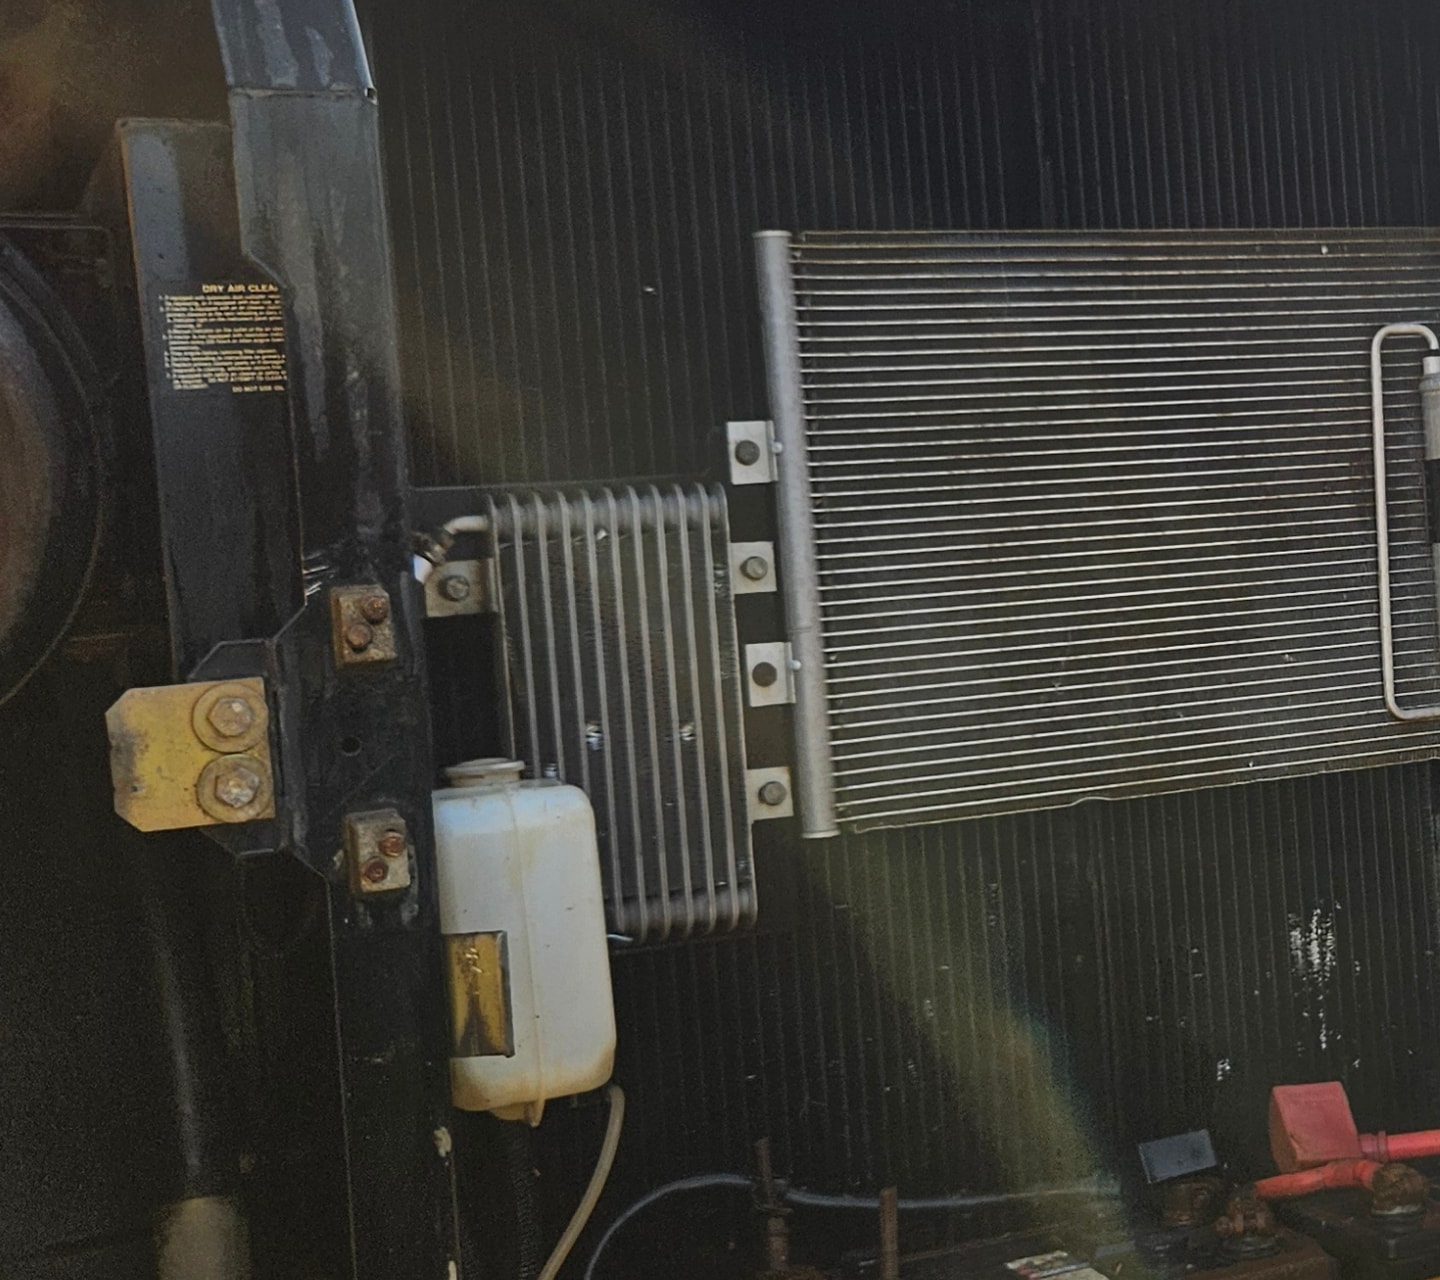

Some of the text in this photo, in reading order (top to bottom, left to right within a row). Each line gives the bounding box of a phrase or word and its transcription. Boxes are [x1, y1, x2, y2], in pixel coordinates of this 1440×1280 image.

[202, 284, 278, 293] DRY AIR CLEA
